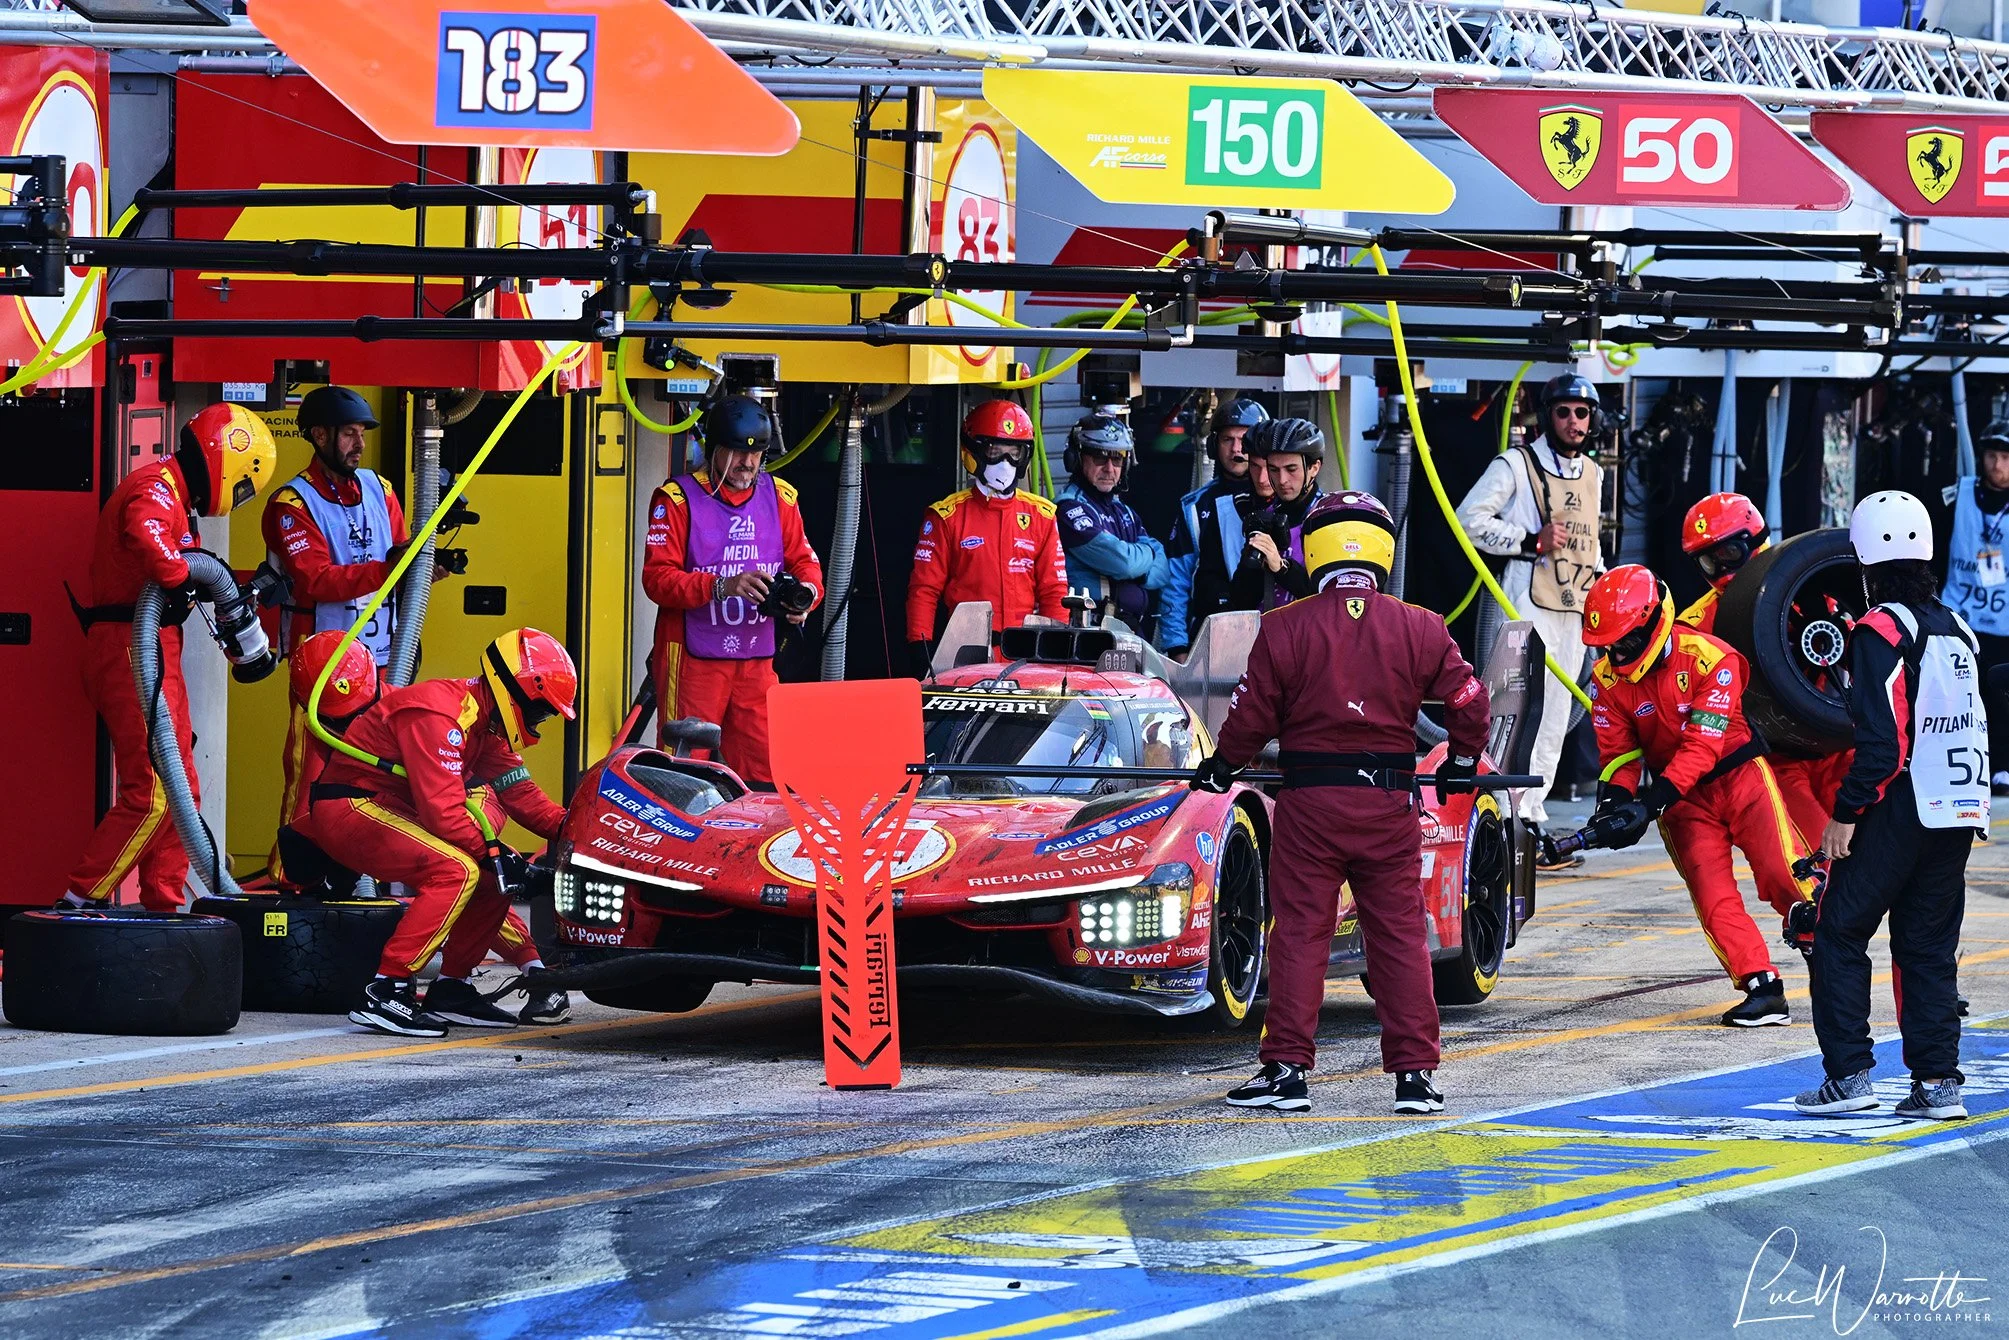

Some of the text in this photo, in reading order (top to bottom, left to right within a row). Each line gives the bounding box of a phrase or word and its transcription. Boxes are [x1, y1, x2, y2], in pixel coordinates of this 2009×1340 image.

[444, 26, 590, 115] 183
[1086, 133, 1171, 145] RICHARD MILLE
[1192, 98, 1319, 178] 150
[1622, 117, 1733, 184] 50
[261, 417, 299, 426] ACIN
[281, 515, 294, 529] hp
[650, 523, 670, 531] rembo
[727, 514, 756, 534] 24h
[723, 544, 759, 562] MEDIA
[1554, 558, 1595, 592] C72
[1959, 582, 2006, 613] 796
[1717, 669, 1732, 686] hp
[922, 696, 1050, 715] Ferrari
[1707, 689, 1731, 704] 24h
[447, 729, 463, 746] hp
[501, 766, 531, 787] PITLAN
[601, 787, 696, 840] ADLER GROUP
[1044, 805, 1171, 853] ADLER GROUP
[590, 837, 720, 877] RICHARD MILLE
[1199, 834, 1214, 863] hp
[968, 858, 1137, 887] RICHARD MILLE
[1440, 866, 1459, 919] 51
[266, 924, 286, 936] FR
[566, 927, 625, 945] V-Power
[1094, 950, 1170, 967] V-Power
